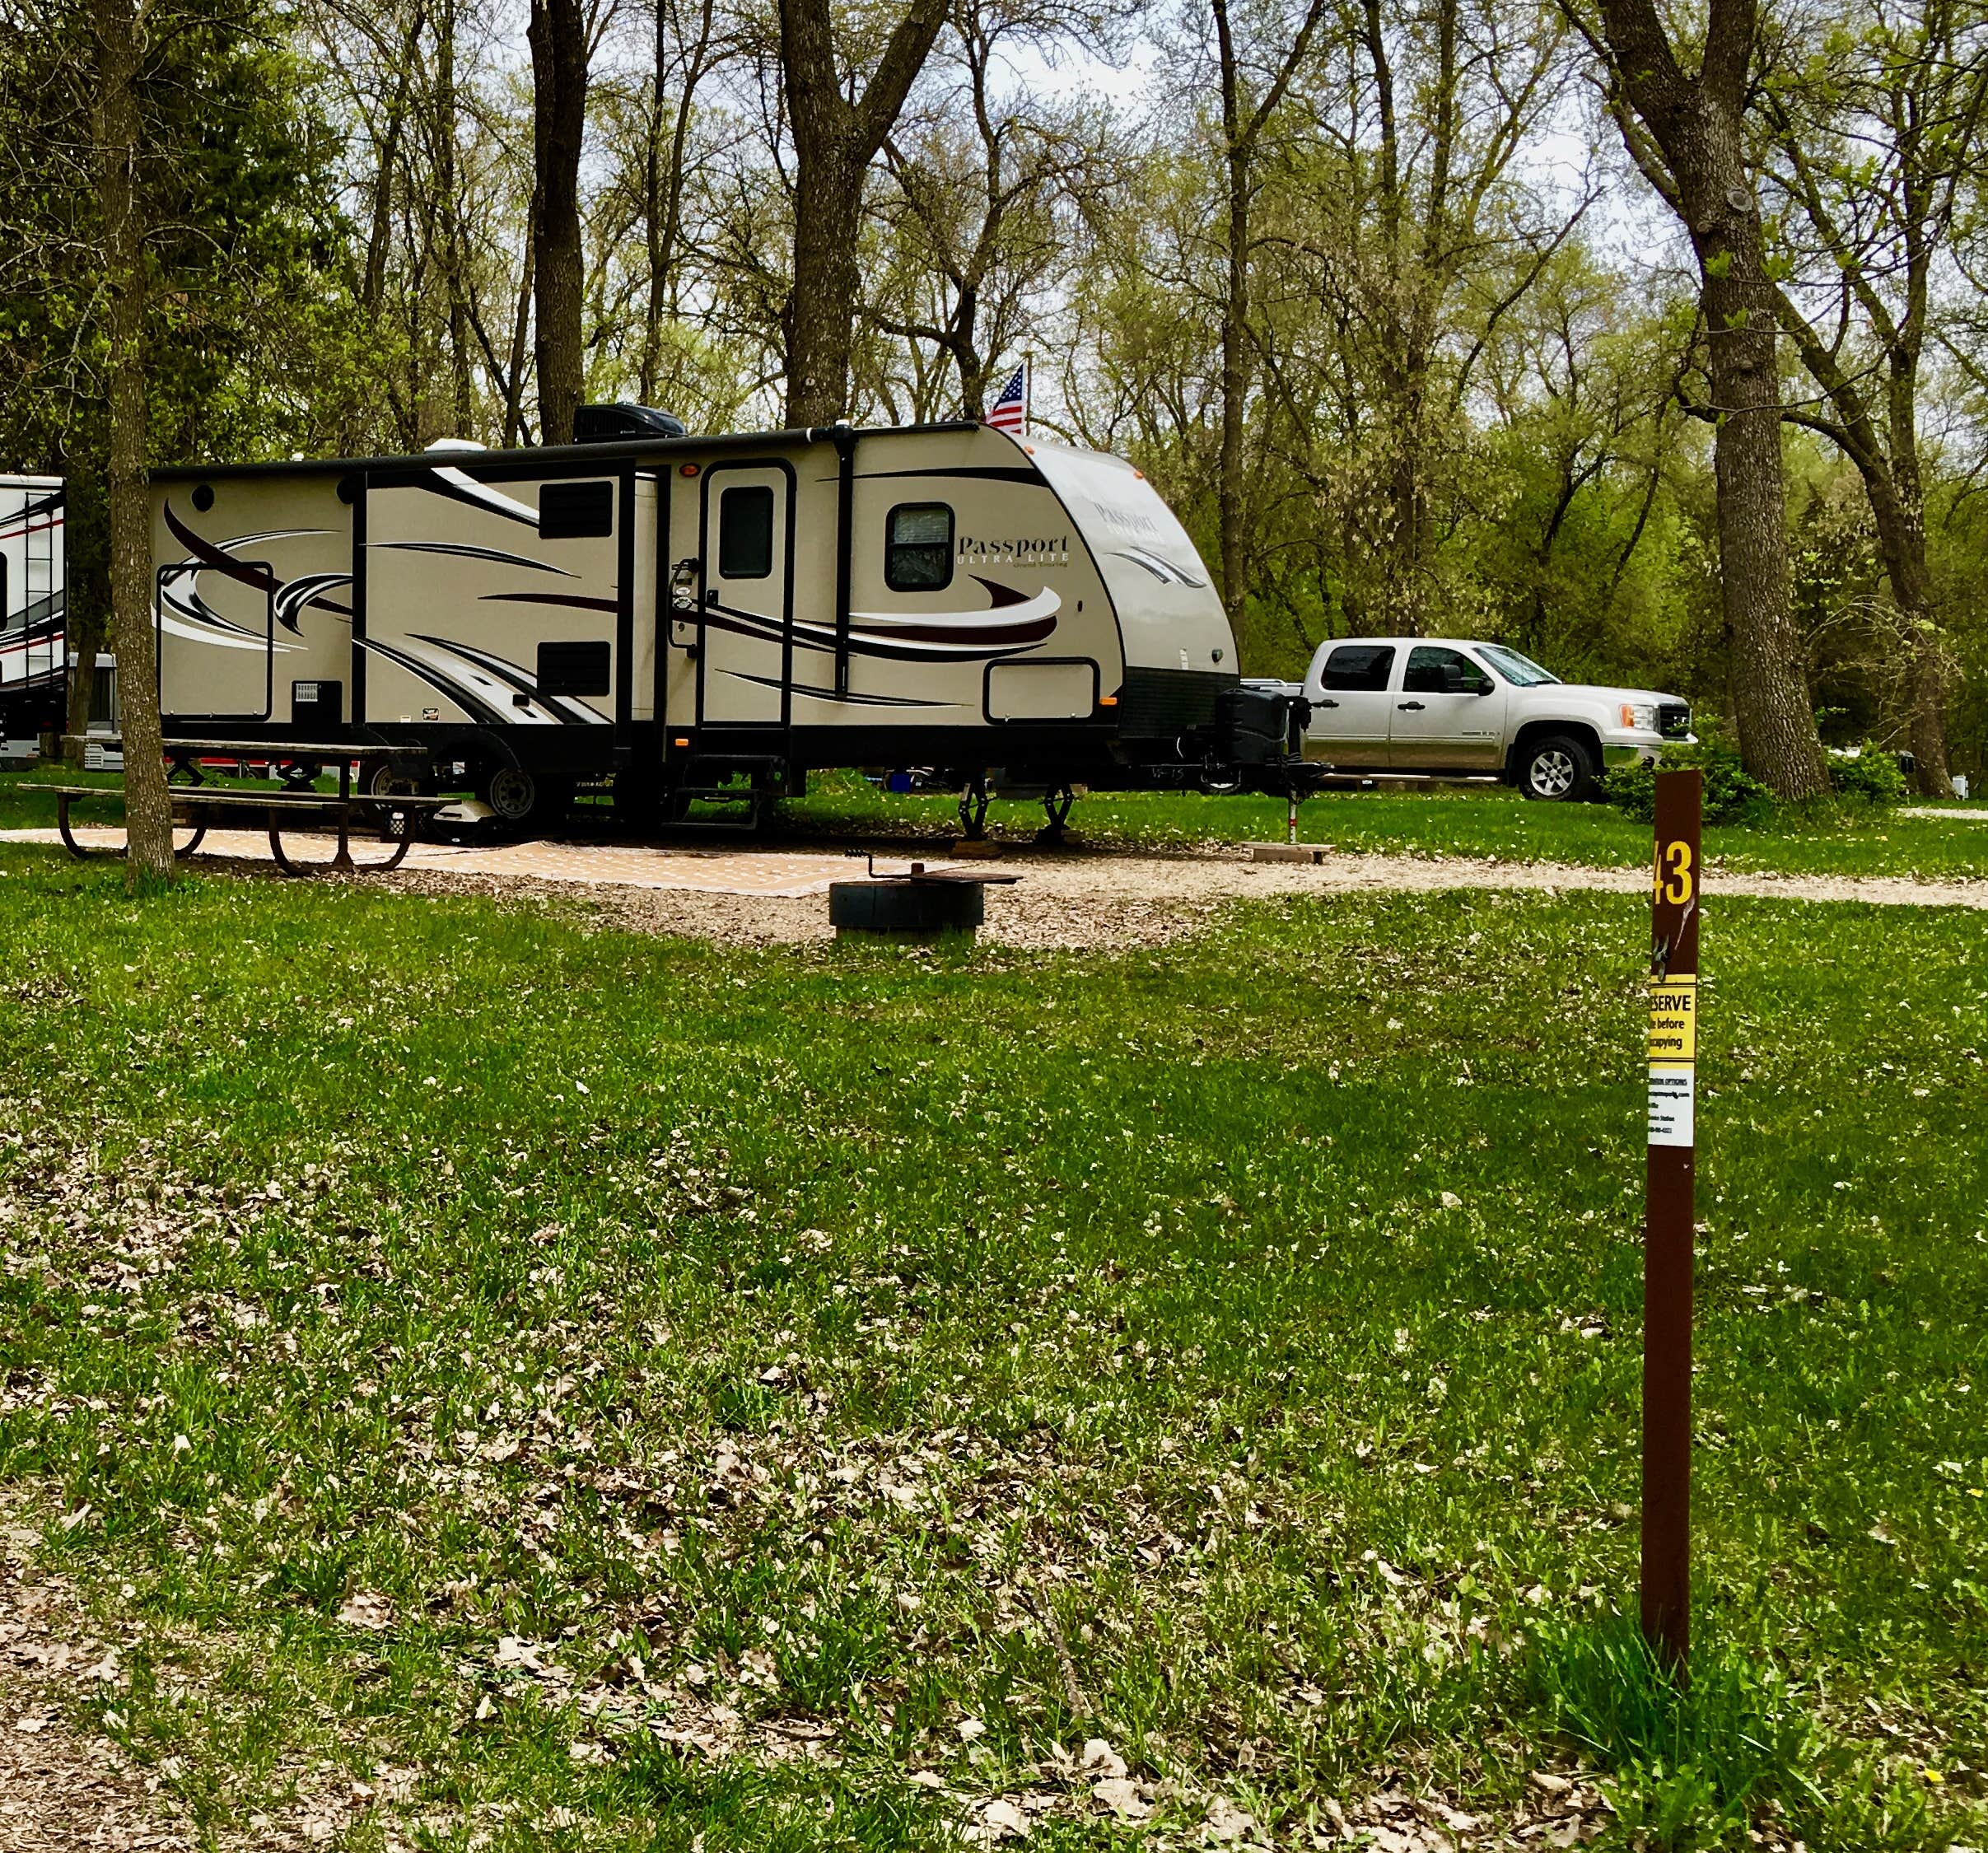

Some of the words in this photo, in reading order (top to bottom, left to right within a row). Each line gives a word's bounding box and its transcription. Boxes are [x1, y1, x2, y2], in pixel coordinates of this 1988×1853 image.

[958, 535, 1068, 558] Passport
[957, 554, 1014, 565] ULTRA
[1028, 553, 1070, 562] LITE
[1652, 840, 1692, 904] 43
[1657, 1017, 1685, 1029] before
